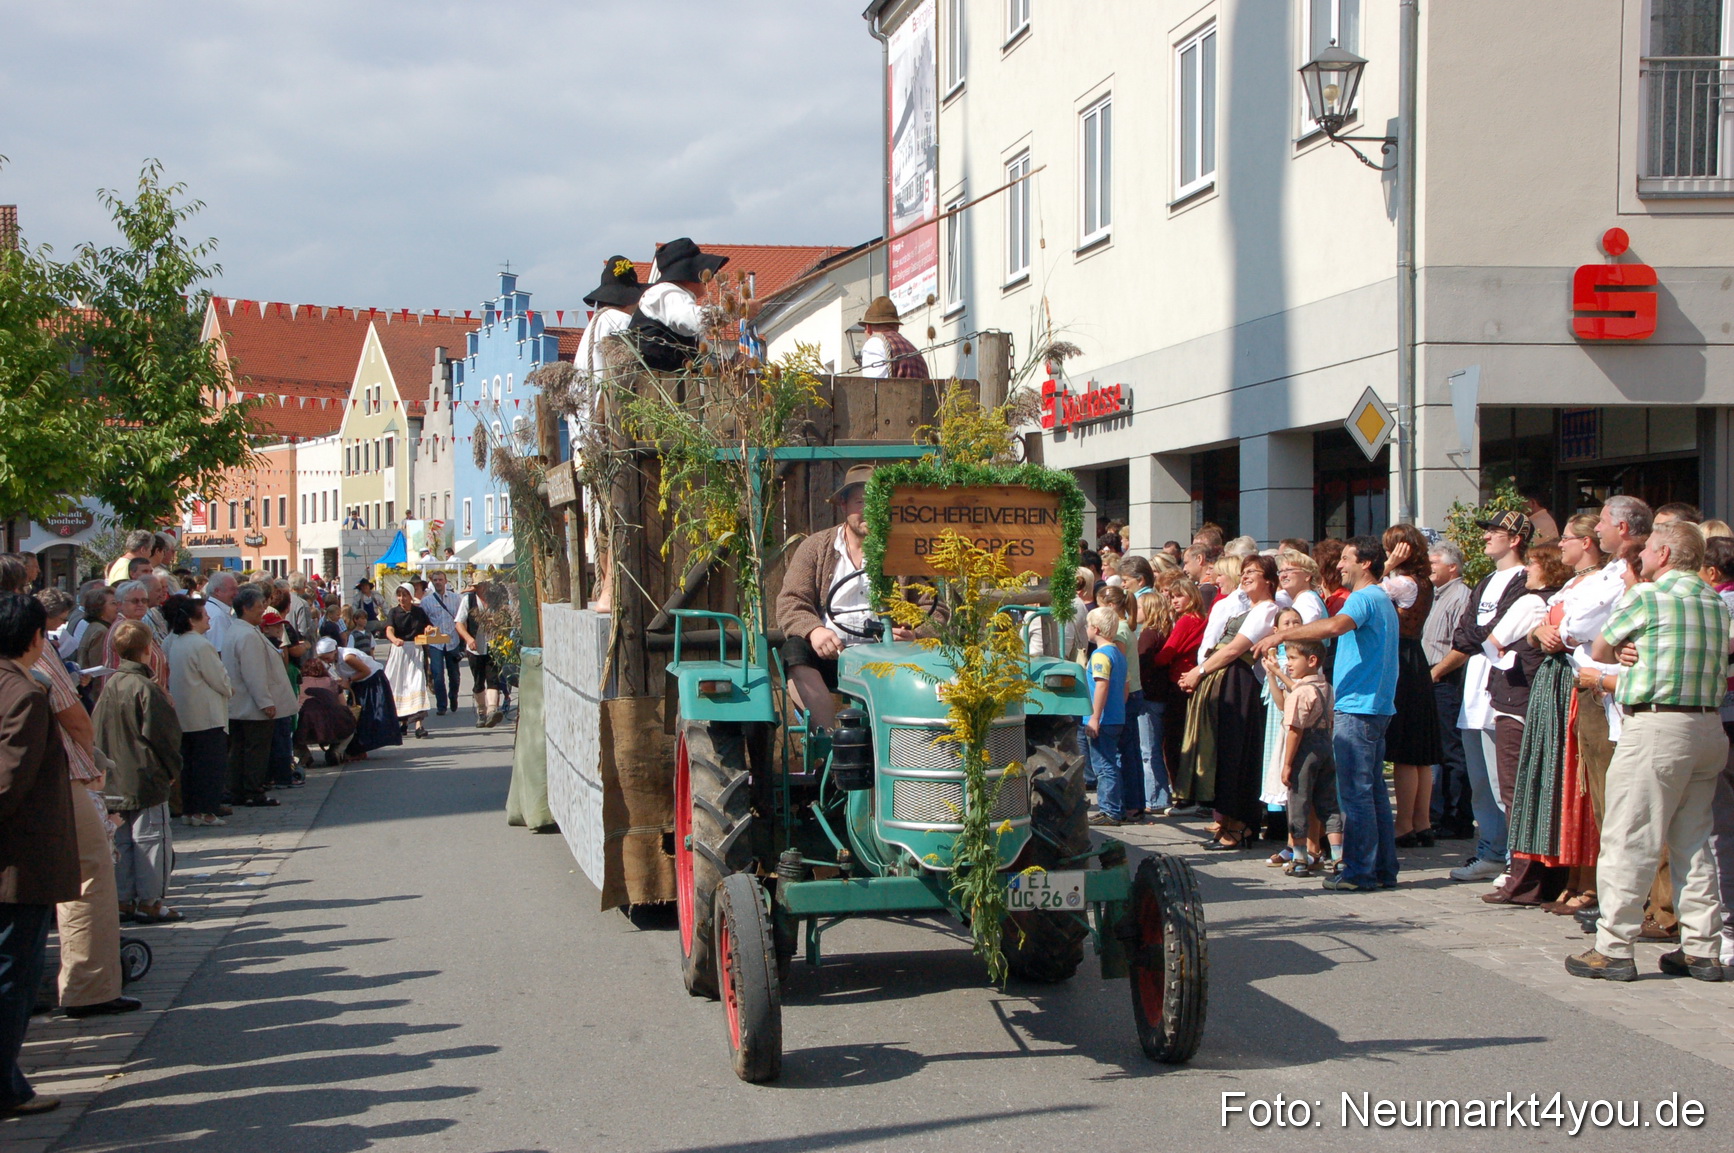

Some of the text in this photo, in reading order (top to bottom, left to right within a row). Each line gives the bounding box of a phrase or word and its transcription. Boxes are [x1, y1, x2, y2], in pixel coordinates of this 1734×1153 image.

[1061, 381, 1122, 433] Sparkasse
[47, 517, 87, 525] Apotheke
[889, 505, 1058, 525] FISCHEREIVEREIN
[1011, 891, 1063, 907] UC 26
